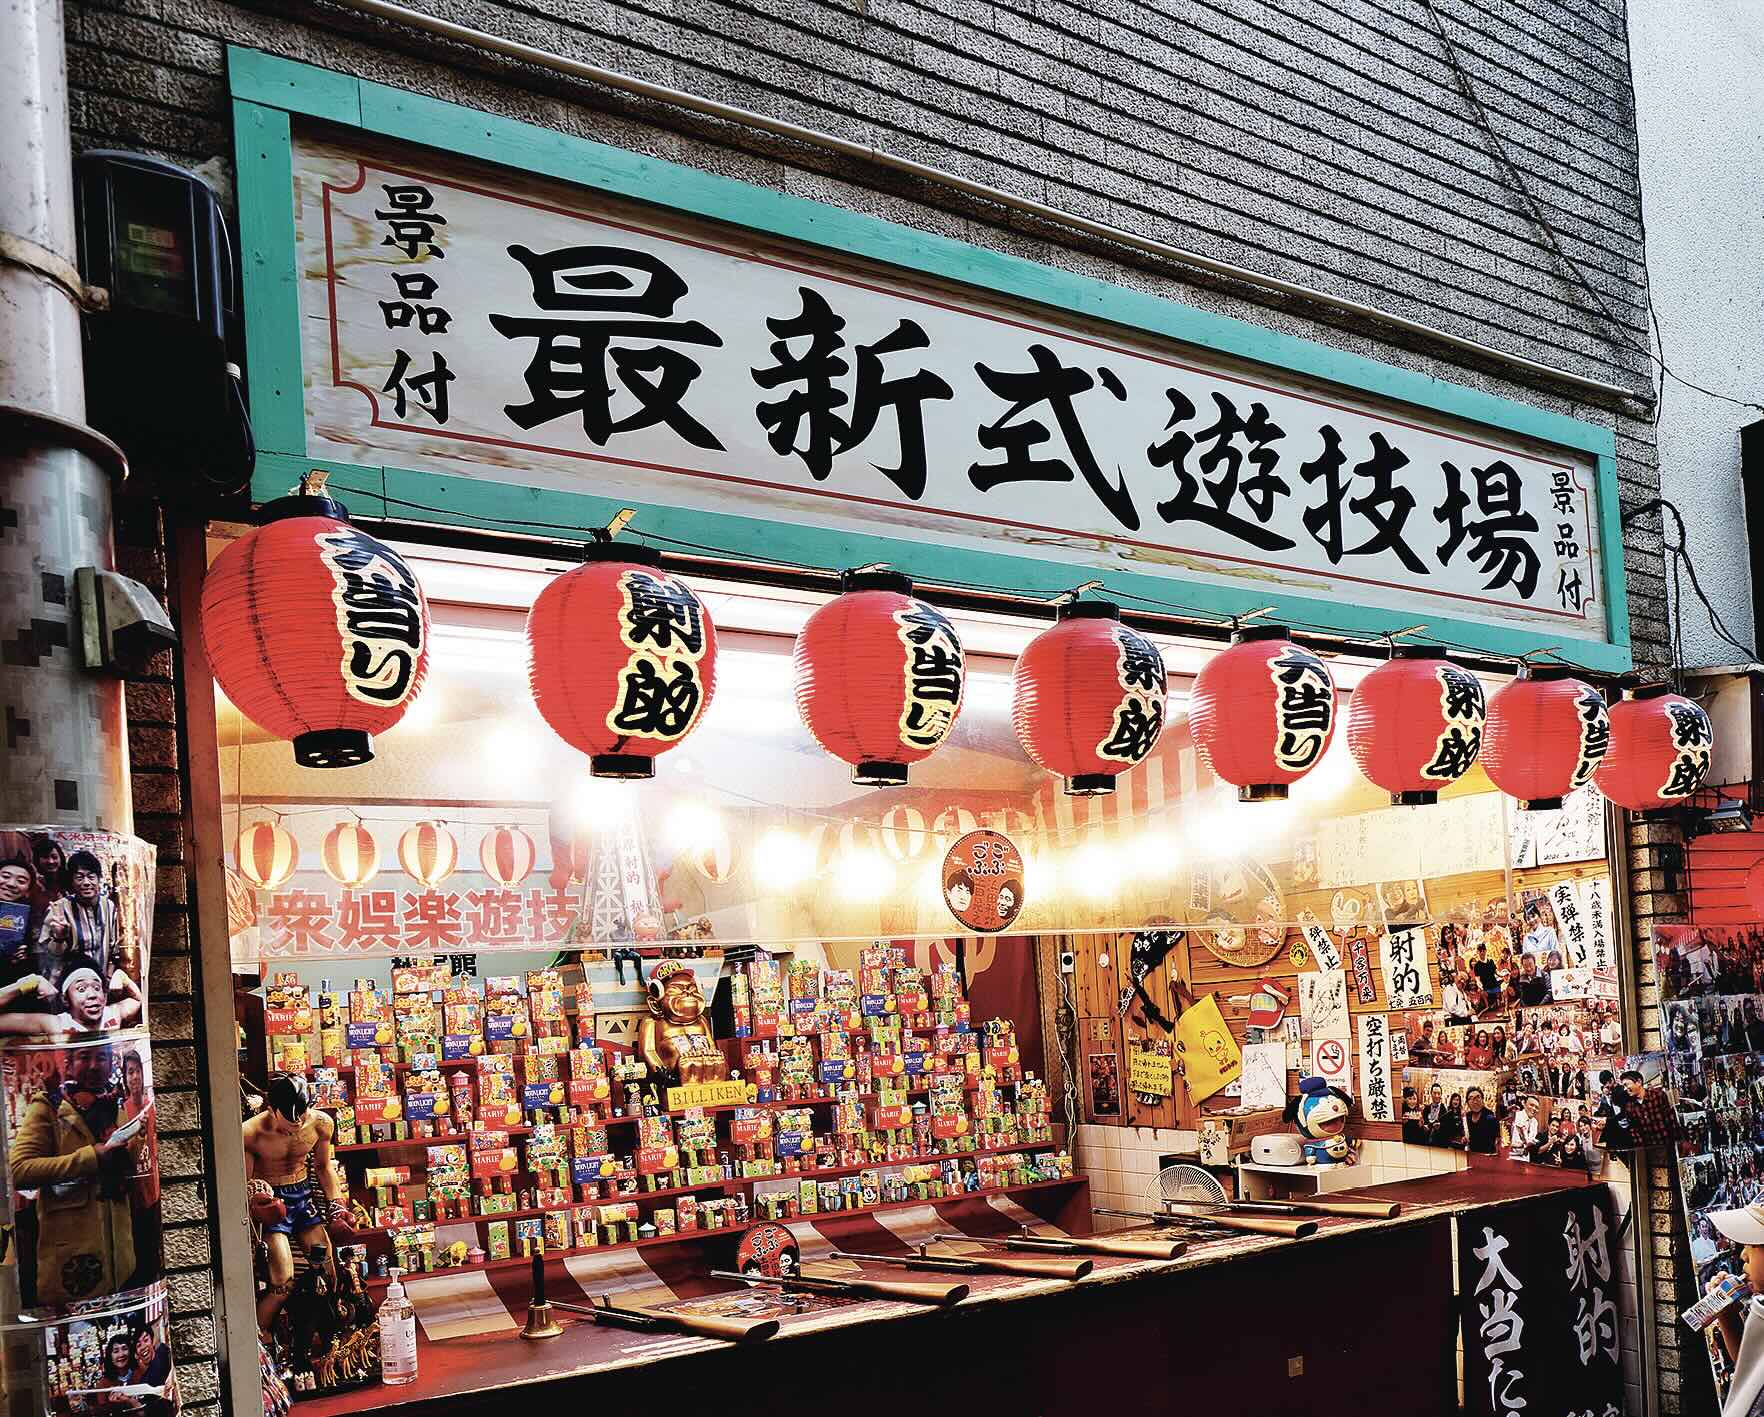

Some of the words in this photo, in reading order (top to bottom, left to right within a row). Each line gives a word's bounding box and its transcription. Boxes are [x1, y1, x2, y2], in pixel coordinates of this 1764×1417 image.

[374, 184, 457, 425] 景品付
[488, 244, 1542, 600] 最新式遊技場
[1549, 469, 1582, 612] 景品付
[325, 529, 420, 701] 大当り
[1272, 649, 1332, 768] 大当り
[256, 888, 581, 951] 衆娯楽遊技
[1389, 931, 1420, 995] 射的
[1554, 885, 1588, 970] 実弾禁止
[268, 1013, 293, 1021] MARIE
[1365, 1017, 1388, 1120] 空打ち厳禁
[357, 1104, 384, 1112] MARIE
[672, 1087, 742, 1105] BILLIKEN
[475, 1155, 500, 1163] MARIE
[1472, 1226, 1526, 1417] 大当た
[1562, 1204, 1620, 1366] 射的
